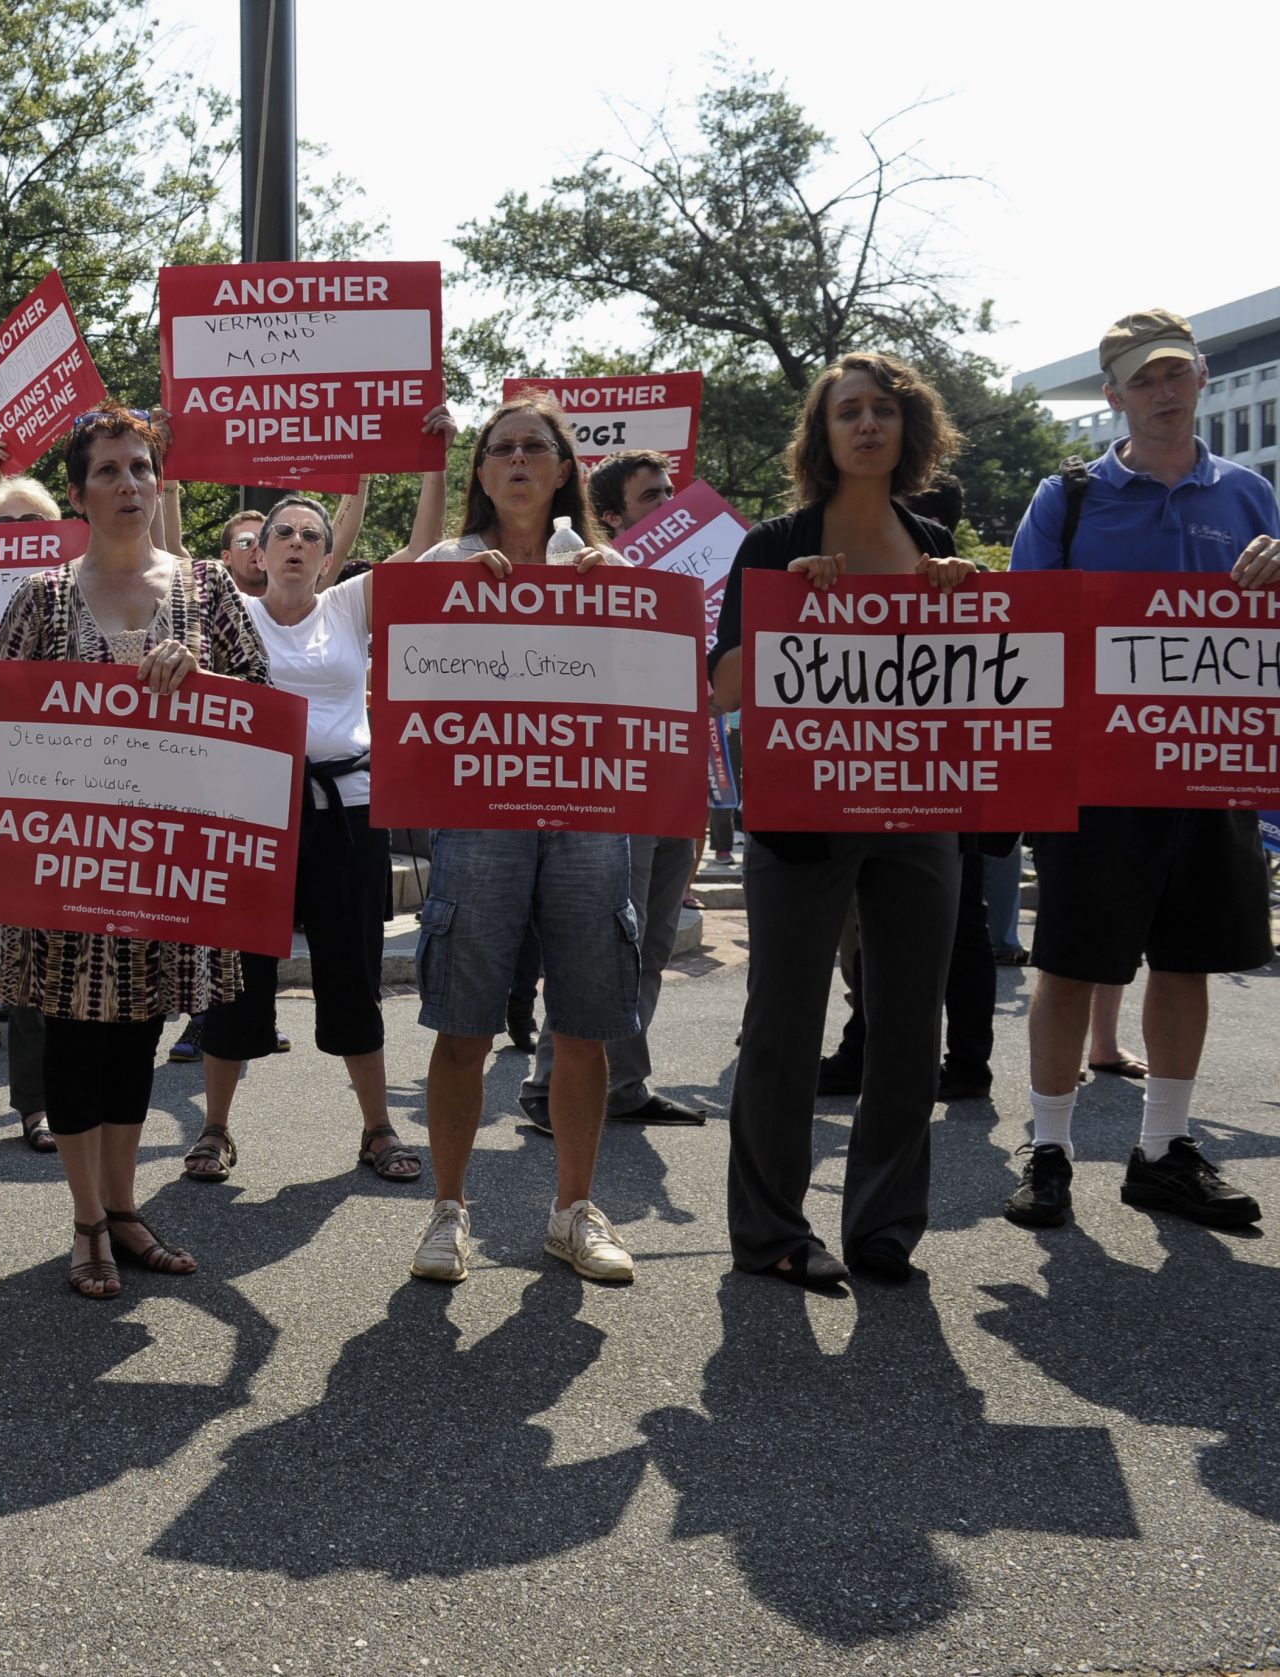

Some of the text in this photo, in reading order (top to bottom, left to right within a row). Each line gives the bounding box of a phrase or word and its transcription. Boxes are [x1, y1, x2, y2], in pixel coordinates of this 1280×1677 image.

[213, 276, 389, 307] ANOTHER
[204, 311, 338, 335] VERMONTER
[267, 326, 316, 342] AND
[52, 348, 83, 383] THE
[226, 349, 302, 368] MOM
[16, 382, 78, 444] PIPELINE
[182, 379, 423, 414] AGAINST THE
[225, 413, 382, 445] PIPELINE
[571, 421, 626, 446] OGI
[253, 453, 353, 463] credoaction.com/keystonexl
[623, 509, 698, 566] OTHER
[441, 580, 658, 620] ANOTHER
[798, 591, 1011, 624] ANOTHER
[1145, 589, 1280, 619] ANOTH
[404, 645, 596, 680] Concerned Citizen
[773, 632, 1030, 707] Student
[1111, 636, 1280, 687] TEACH
[40, 680, 254, 734] ANOTHER
[9, 725, 208, 758] Steward of the Earth
[398, 712, 689, 755] AGAINST THE
[766, 718, 1052, 752] AGAINST THE
[103, 755, 127, 767] and
[453, 754, 647, 793] PIPELINE
[1155, 742, 1278, 773] PIPELI
[7, 768, 140, 793] Voice for Wildlife
[813, 760, 998, 792] PIPELINE
[488, 802, 616, 814] credoaction.com/keystonexl
[842, 806, 963, 815] credoaction.com/keystonexl
[200, 827, 278, 872] THE
[34, 853, 229, 906] PIPELINE
[63, 903, 189, 924] credoaction.com/keystonexl
